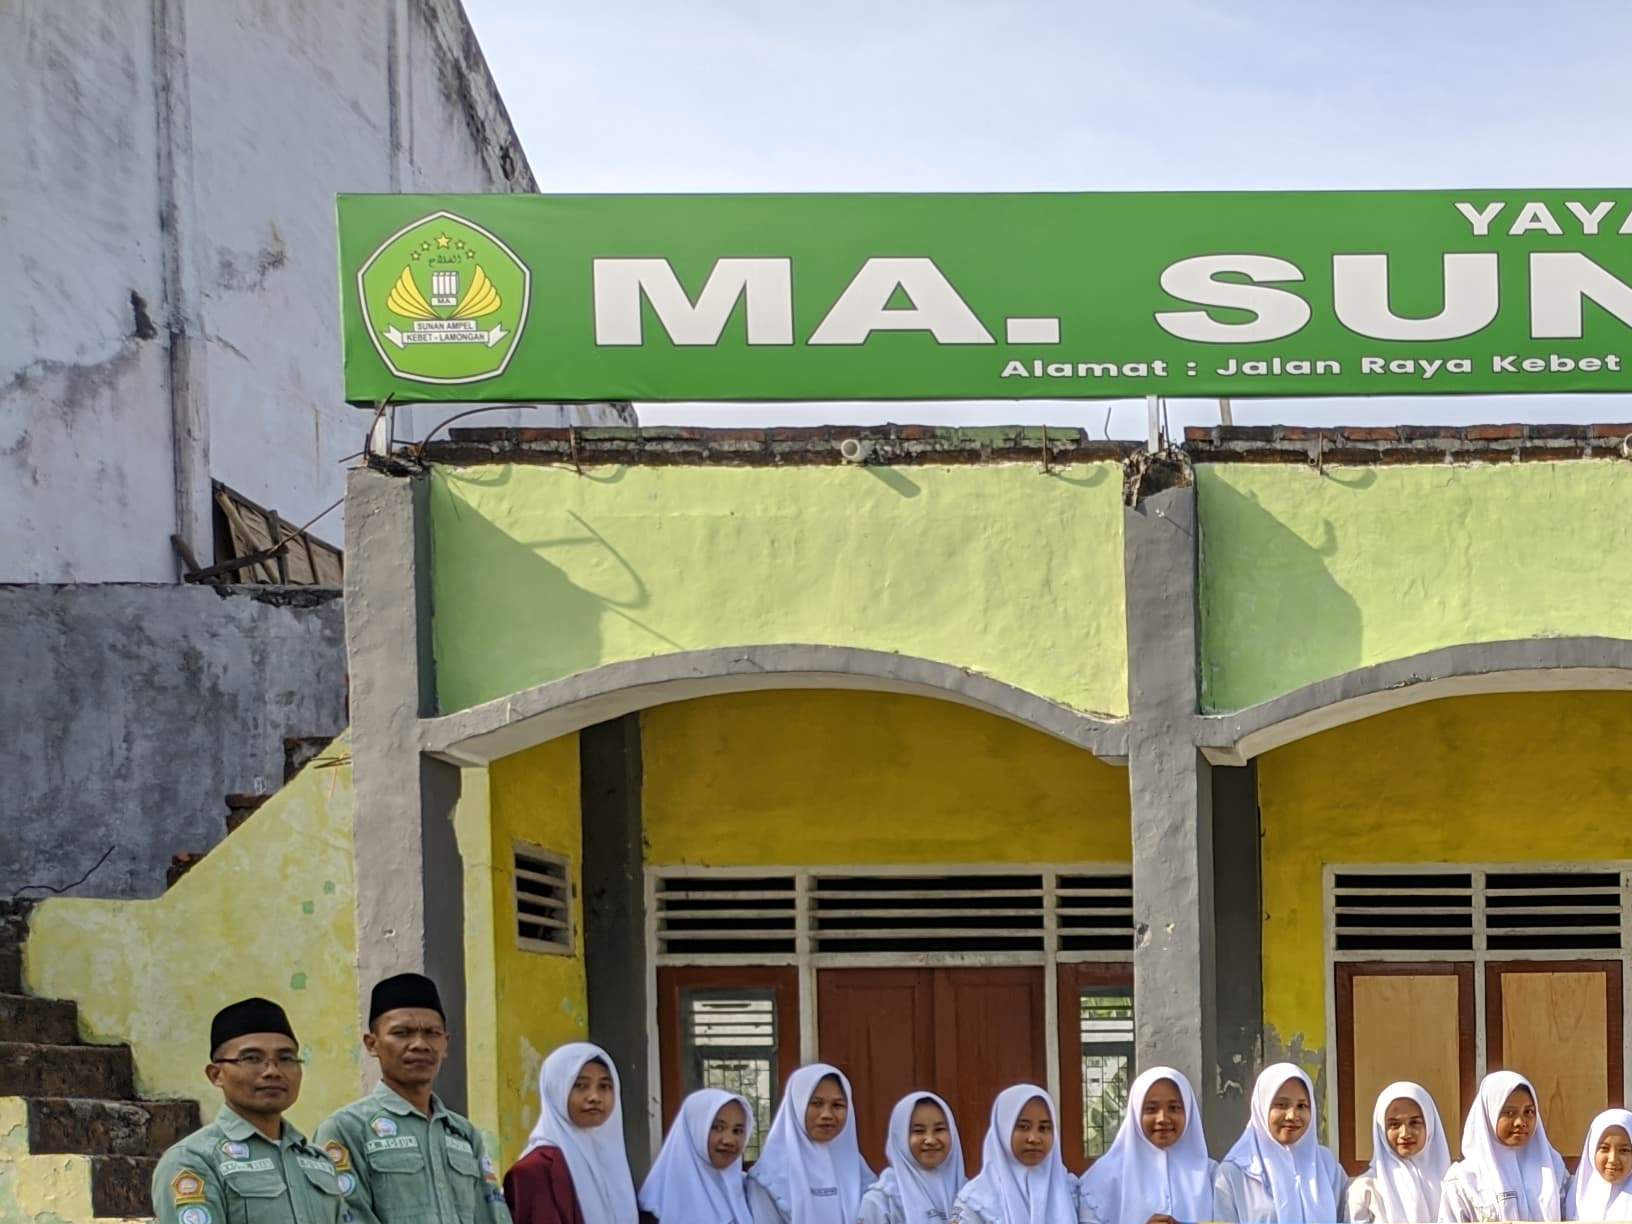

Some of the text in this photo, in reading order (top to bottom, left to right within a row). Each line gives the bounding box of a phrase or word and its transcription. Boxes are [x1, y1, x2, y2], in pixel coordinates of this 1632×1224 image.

[592, 256, 1061, 347] MA.
[417, 322, 473, 330] SUNAN AMPEL
[406, 333, 433, 341] KEBET
[440, 333, 485, 341] LAMONGAN
[1000, 358, 1169, 378] Alamat
[1216, 356, 1342, 376] Jalan
[1360, 356, 1472, 379] Raya
[1492, 353, 1622, 374] Kebet
